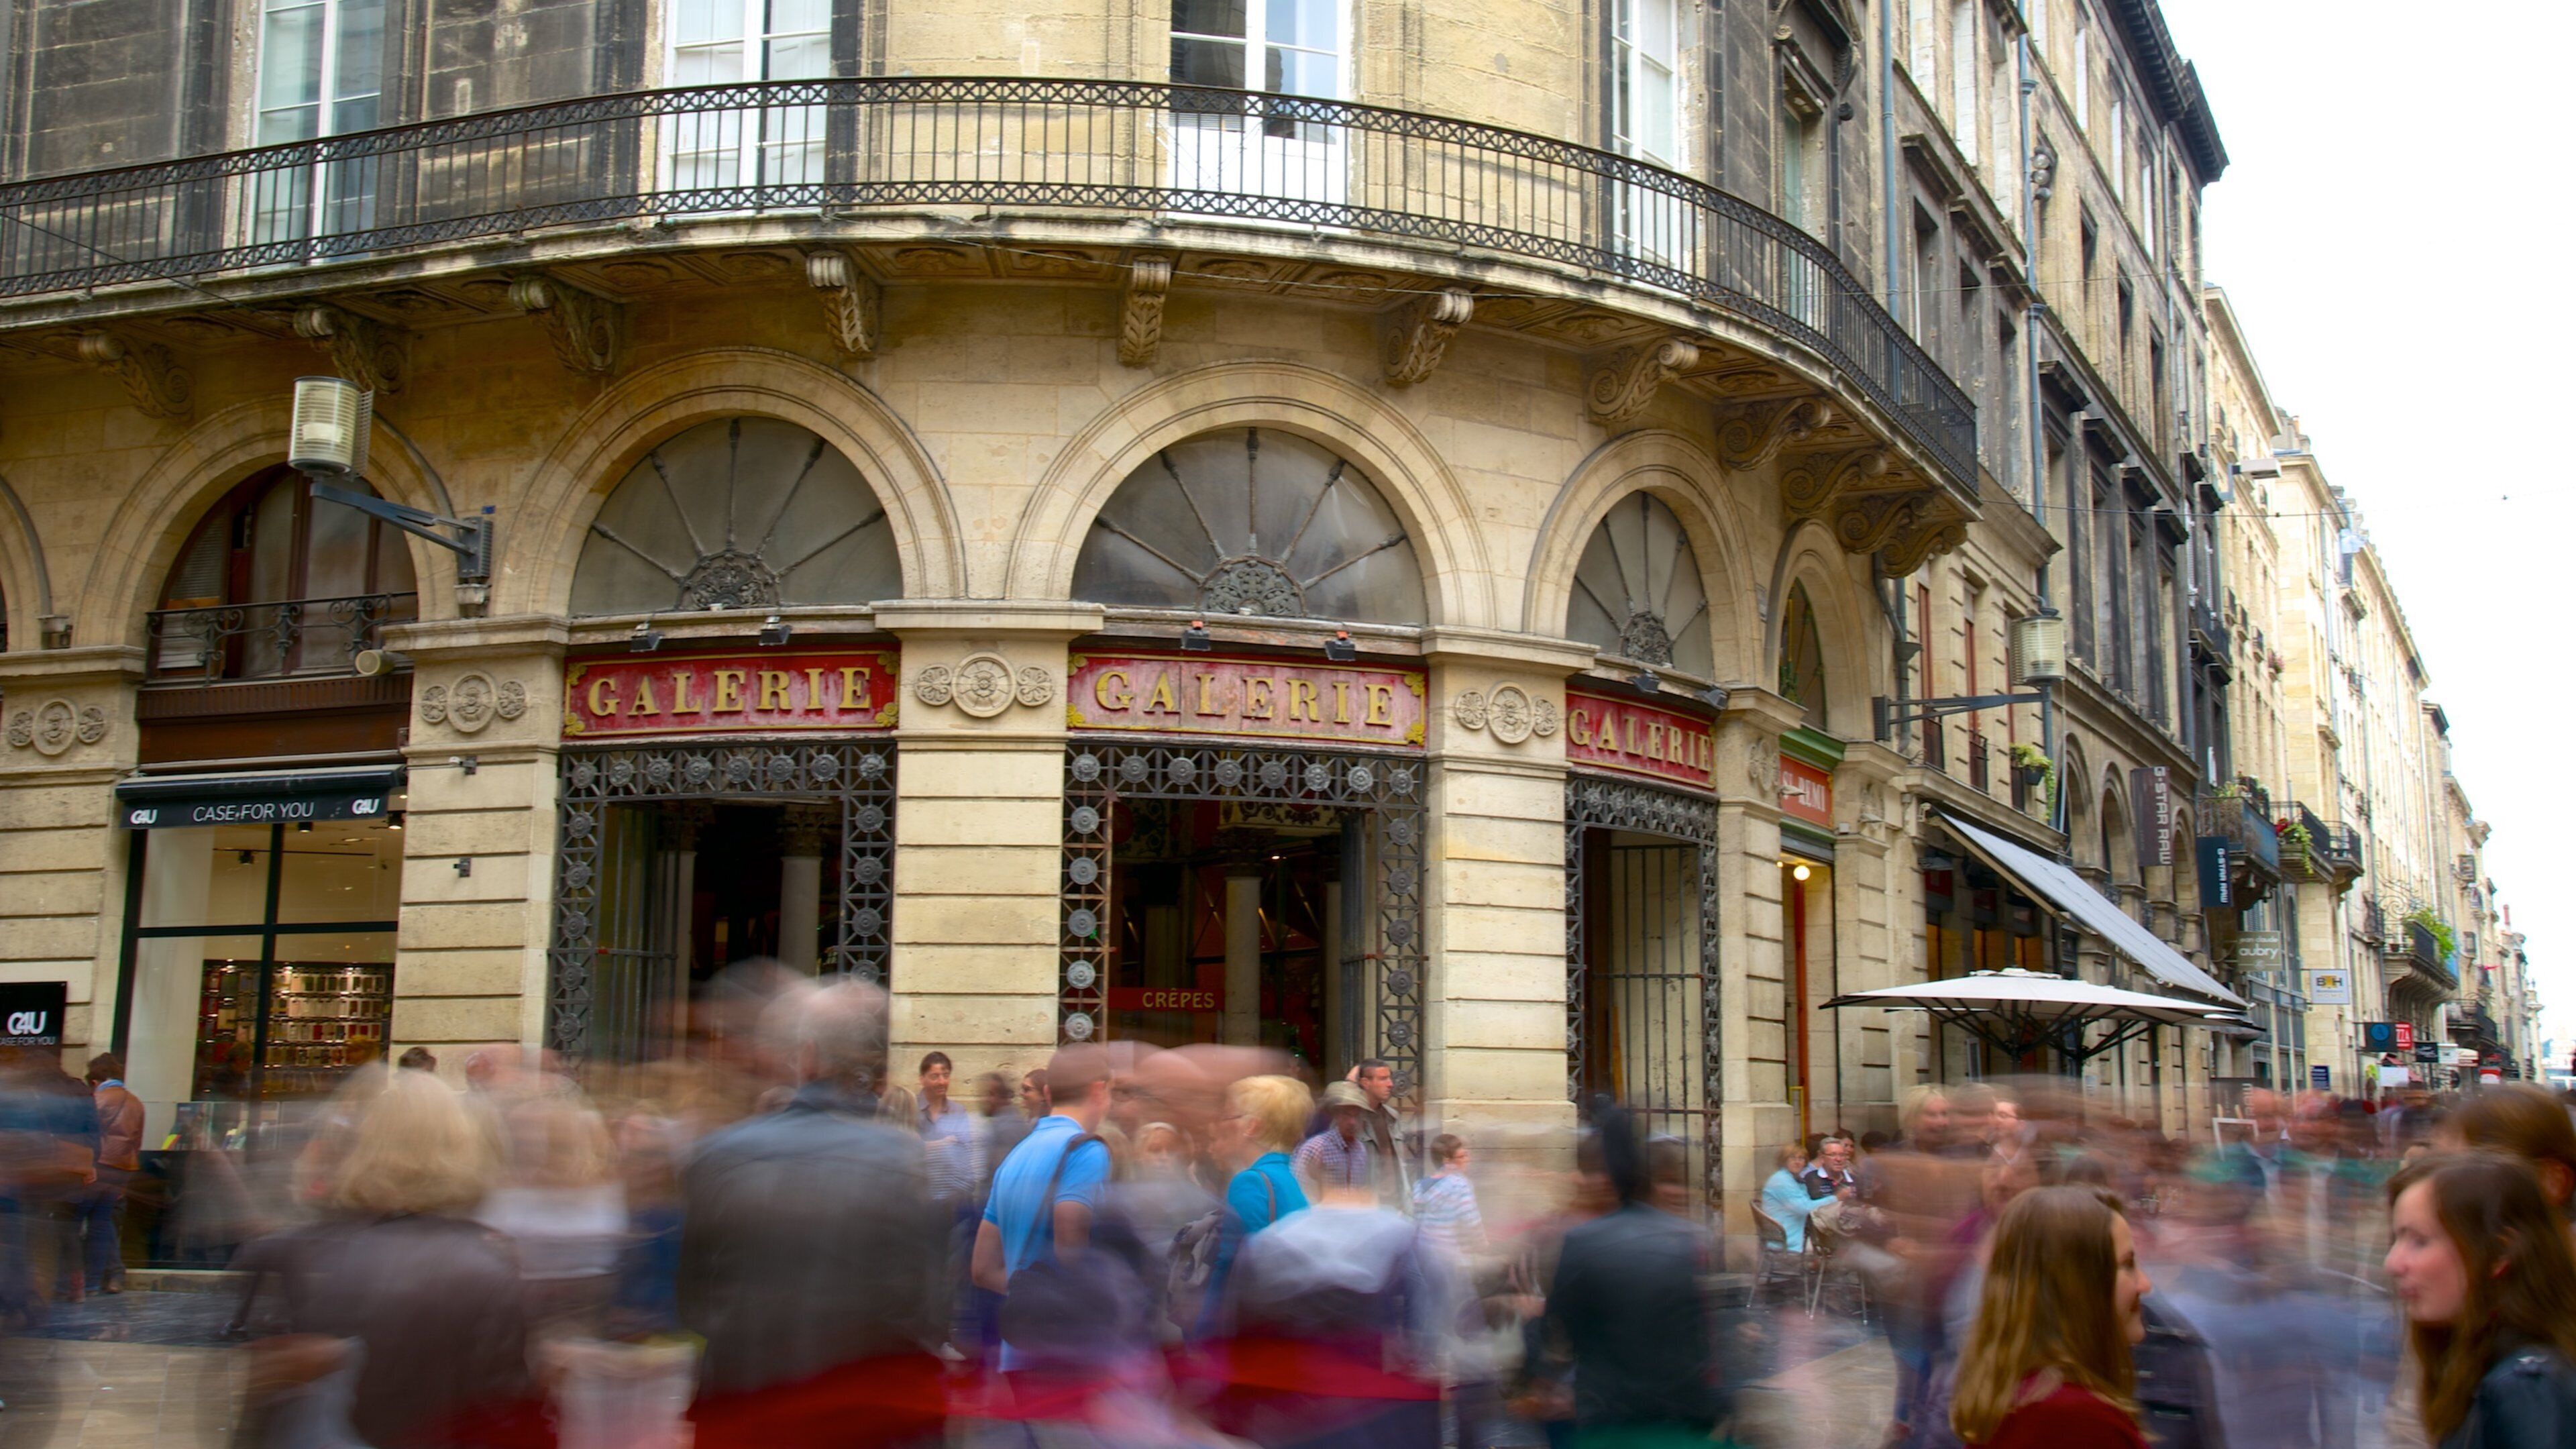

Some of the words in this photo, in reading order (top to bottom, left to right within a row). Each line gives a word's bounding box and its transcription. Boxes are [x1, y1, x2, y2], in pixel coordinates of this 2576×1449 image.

[588, 667, 871, 716] GALERIE
[1095, 671, 1393, 726] GALERIE
[1568, 708, 1711, 772] GALERIE
[2153, 765, 2169, 824] G-STAR
[129, 808, 158, 824] C4U
[193, 805, 237, 822] CASE
[240, 804, 276, 820] FOR
[279, 802, 315, 818] YOU
[351, 798, 380, 815] C4U
[2157, 828, 2171, 865] RAW
[2219, 882, 2229, 903] RAW
[2239, 943, 2279, 960] aubry
[1142, 987, 1215, 1008] CRÊPES
[7, 1010, 48, 1035] C4U
[18, 1036, 36, 1046] FOR
[36, 1036, 56, 1045] YOU
